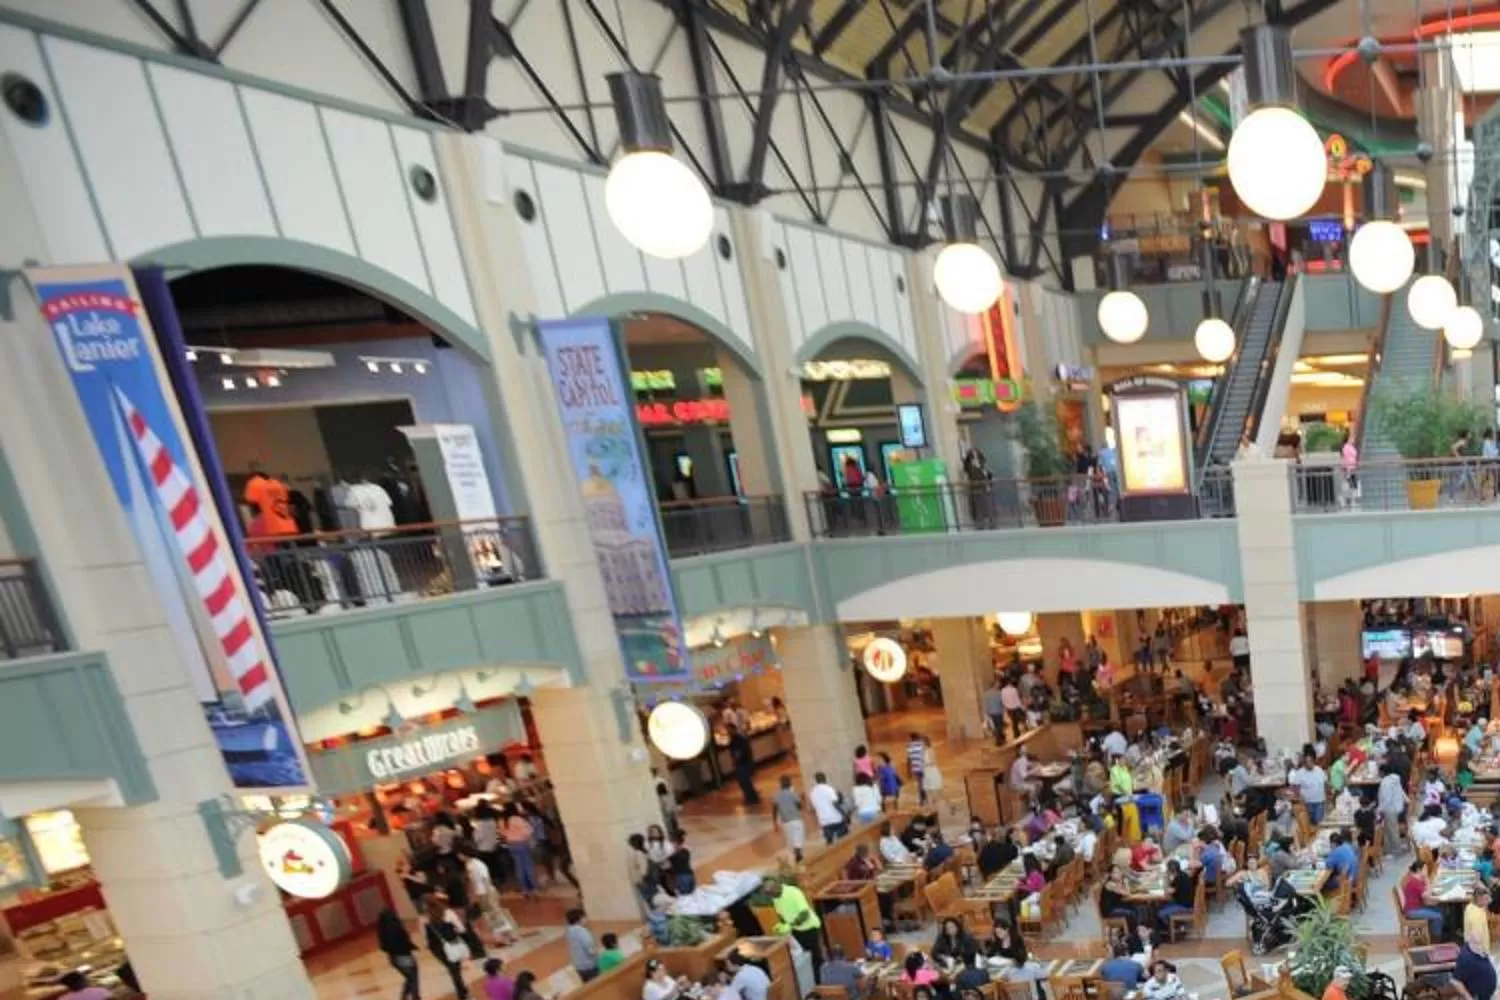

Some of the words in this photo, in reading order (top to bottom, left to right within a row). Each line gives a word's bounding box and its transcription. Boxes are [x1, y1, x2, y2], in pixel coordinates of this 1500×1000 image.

[67, 311, 121, 338] Lake
[55, 321, 139, 373] Lanier
[556, 344, 604, 377] STATE
